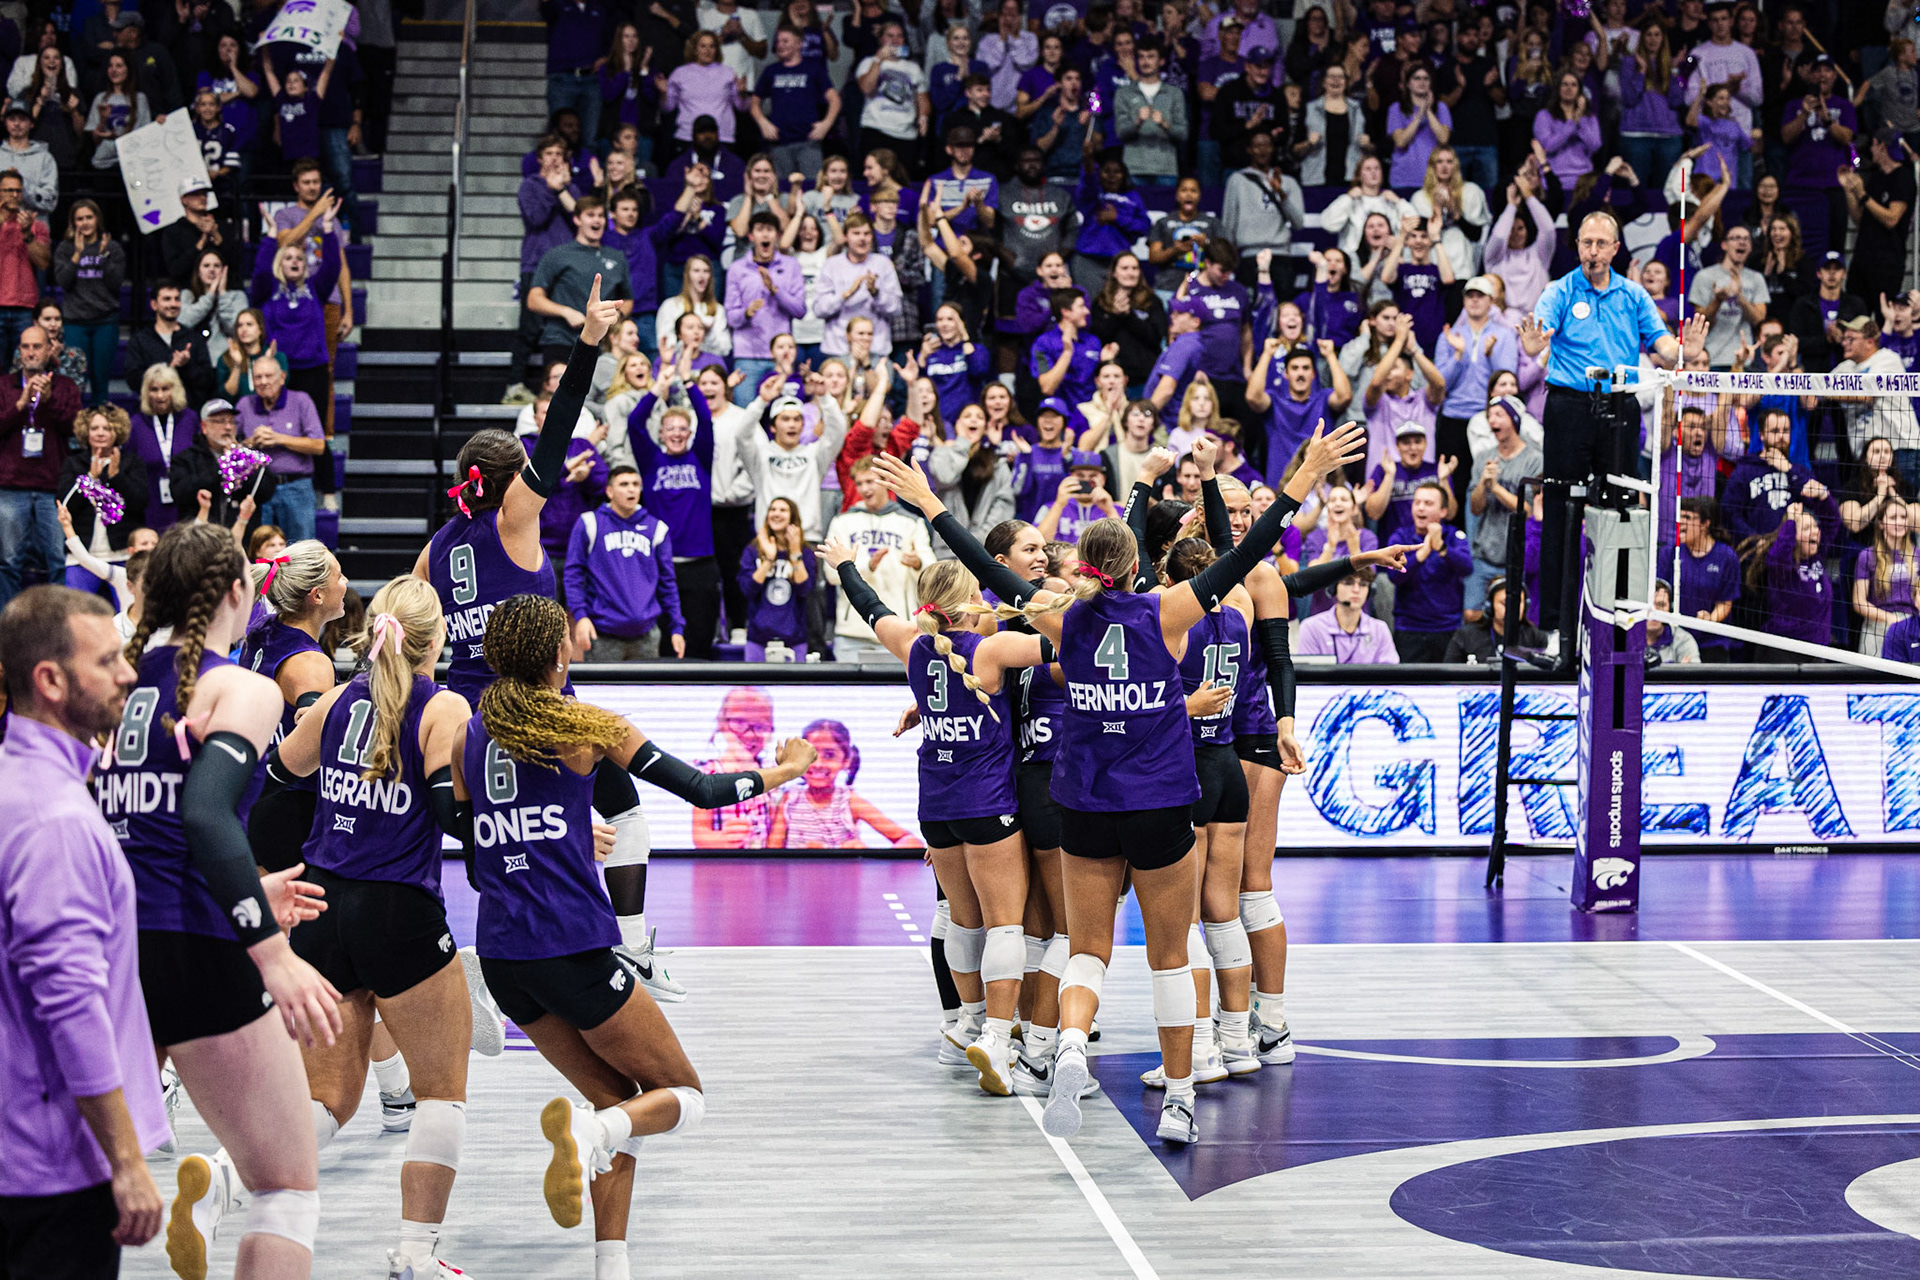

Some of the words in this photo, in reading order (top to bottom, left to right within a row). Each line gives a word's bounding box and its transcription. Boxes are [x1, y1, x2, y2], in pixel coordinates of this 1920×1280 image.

[266, 26, 321, 45] CATS
[199, 140, 222, 172] 2
[1011, 201, 1058, 214] CHIEFS
[1695, 374, 1719, 388] K-STATE
[1737, 374, 1764, 389] K-STATE
[1784, 375, 1812, 390] K-STATE
[1832, 375, 1863, 391] K-STATE
[1886, 375, 1919, 391] K-STATE
[604, 530, 651, 557] WILDCATS
[850, 530, 903, 549] K-STATE
[450, 543, 477, 605] 9
[1094, 624, 1129, 680] 4
[1203, 643, 1240, 690] 15
[927, 660, 948, 712] 3
[1020, 666, 1034, 717] 7
[1068, 680, 1166, 712] FERNHOLZ
[114, 686, 160, 767] 8
[920, 714, 984, 742] AMSEY
[1019, 717, 1053, 749] IMS
[485, 739, 518, 805] 6
[1609, 750, 1624, 794] sports
[95, 772, 183, 815] HMIDT
[320, 766, 412, 815] LEGRAND
[474, 804, 568, 848] ONES
[1608, 795, 1622, 849] imports
